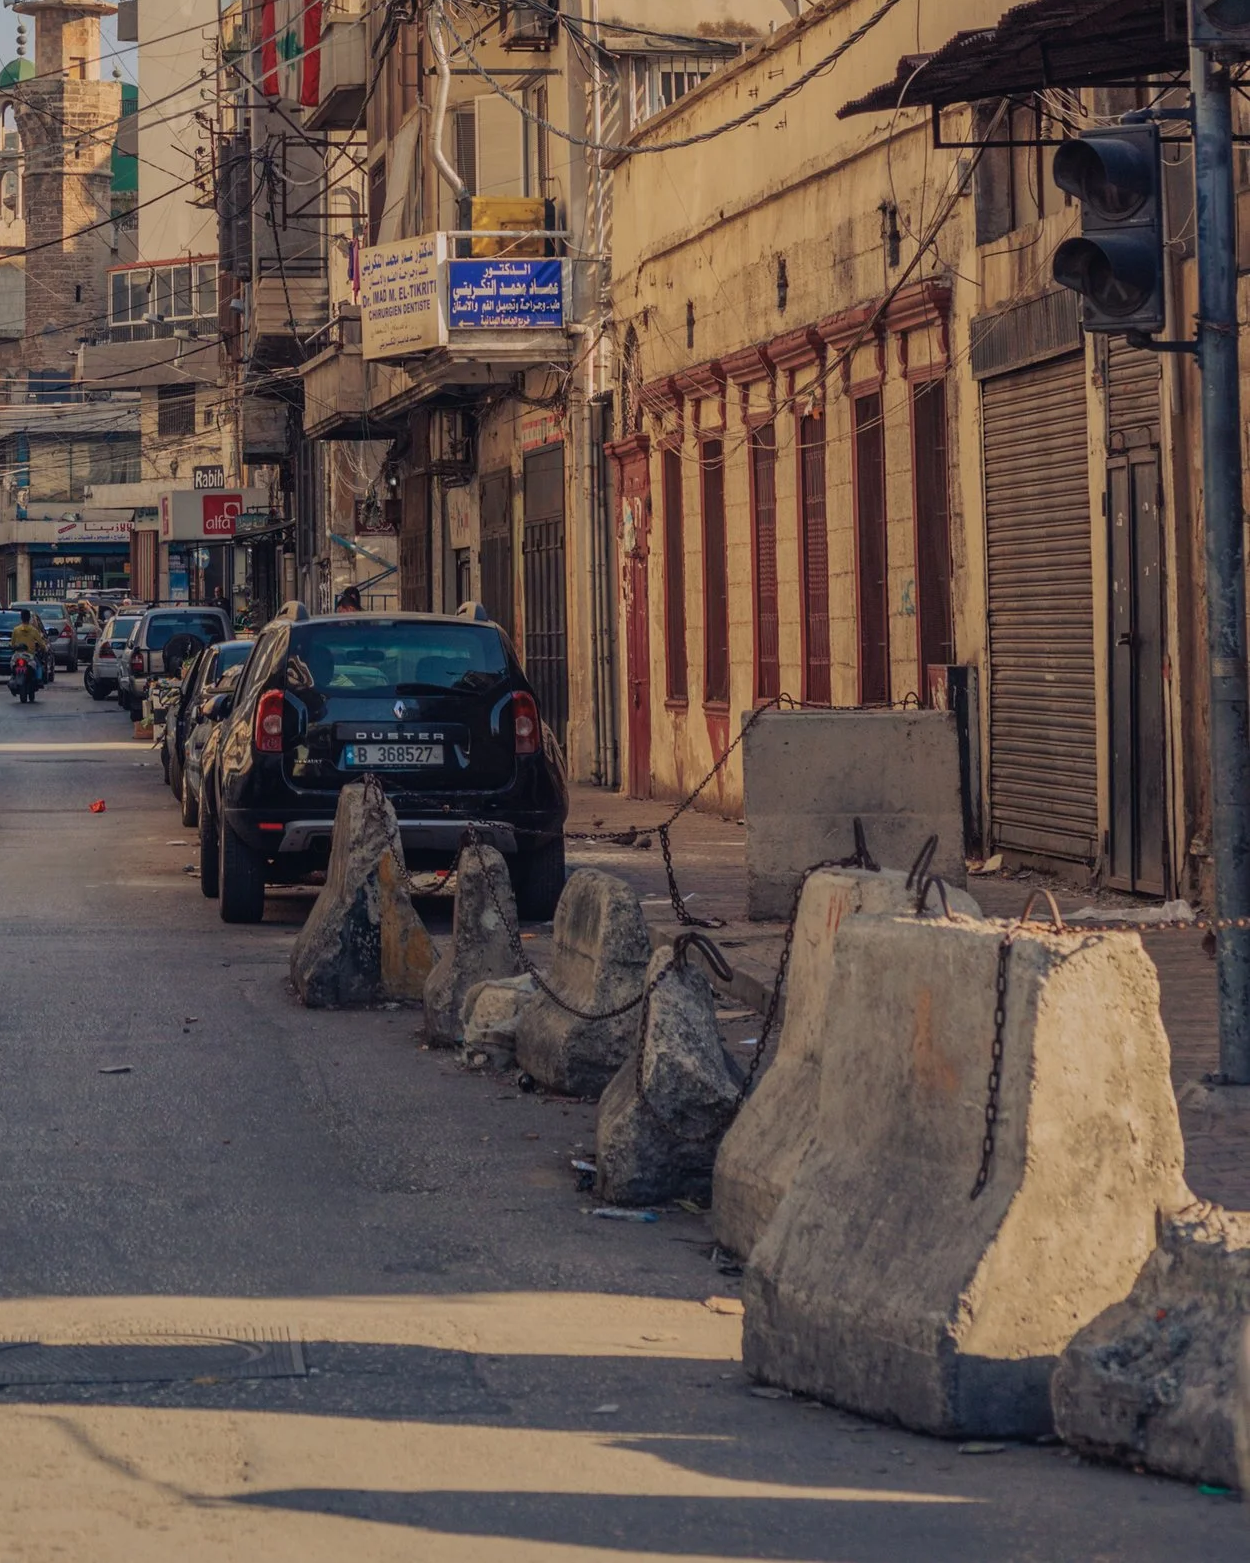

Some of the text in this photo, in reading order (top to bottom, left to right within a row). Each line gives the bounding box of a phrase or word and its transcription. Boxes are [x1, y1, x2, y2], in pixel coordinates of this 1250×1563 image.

[483, 263, 531, 279] الدكتور
[362, 280, 437, 309] Dr. IMAD M. EL-TIKRITI
[499, 282, 527, 296] محمد
[529, 278, 559, 295] عماد
[368, 299, 431, 321] CHIRURGIEN DENTISTE
[481, 299, 495, 314] الفم
[195, 469, 224, 488] Rabih
[206, 515, 231, 530] alfa
[356, 732, 445, 741] DUSTER
[358, 746, 433, 763] B 368527
